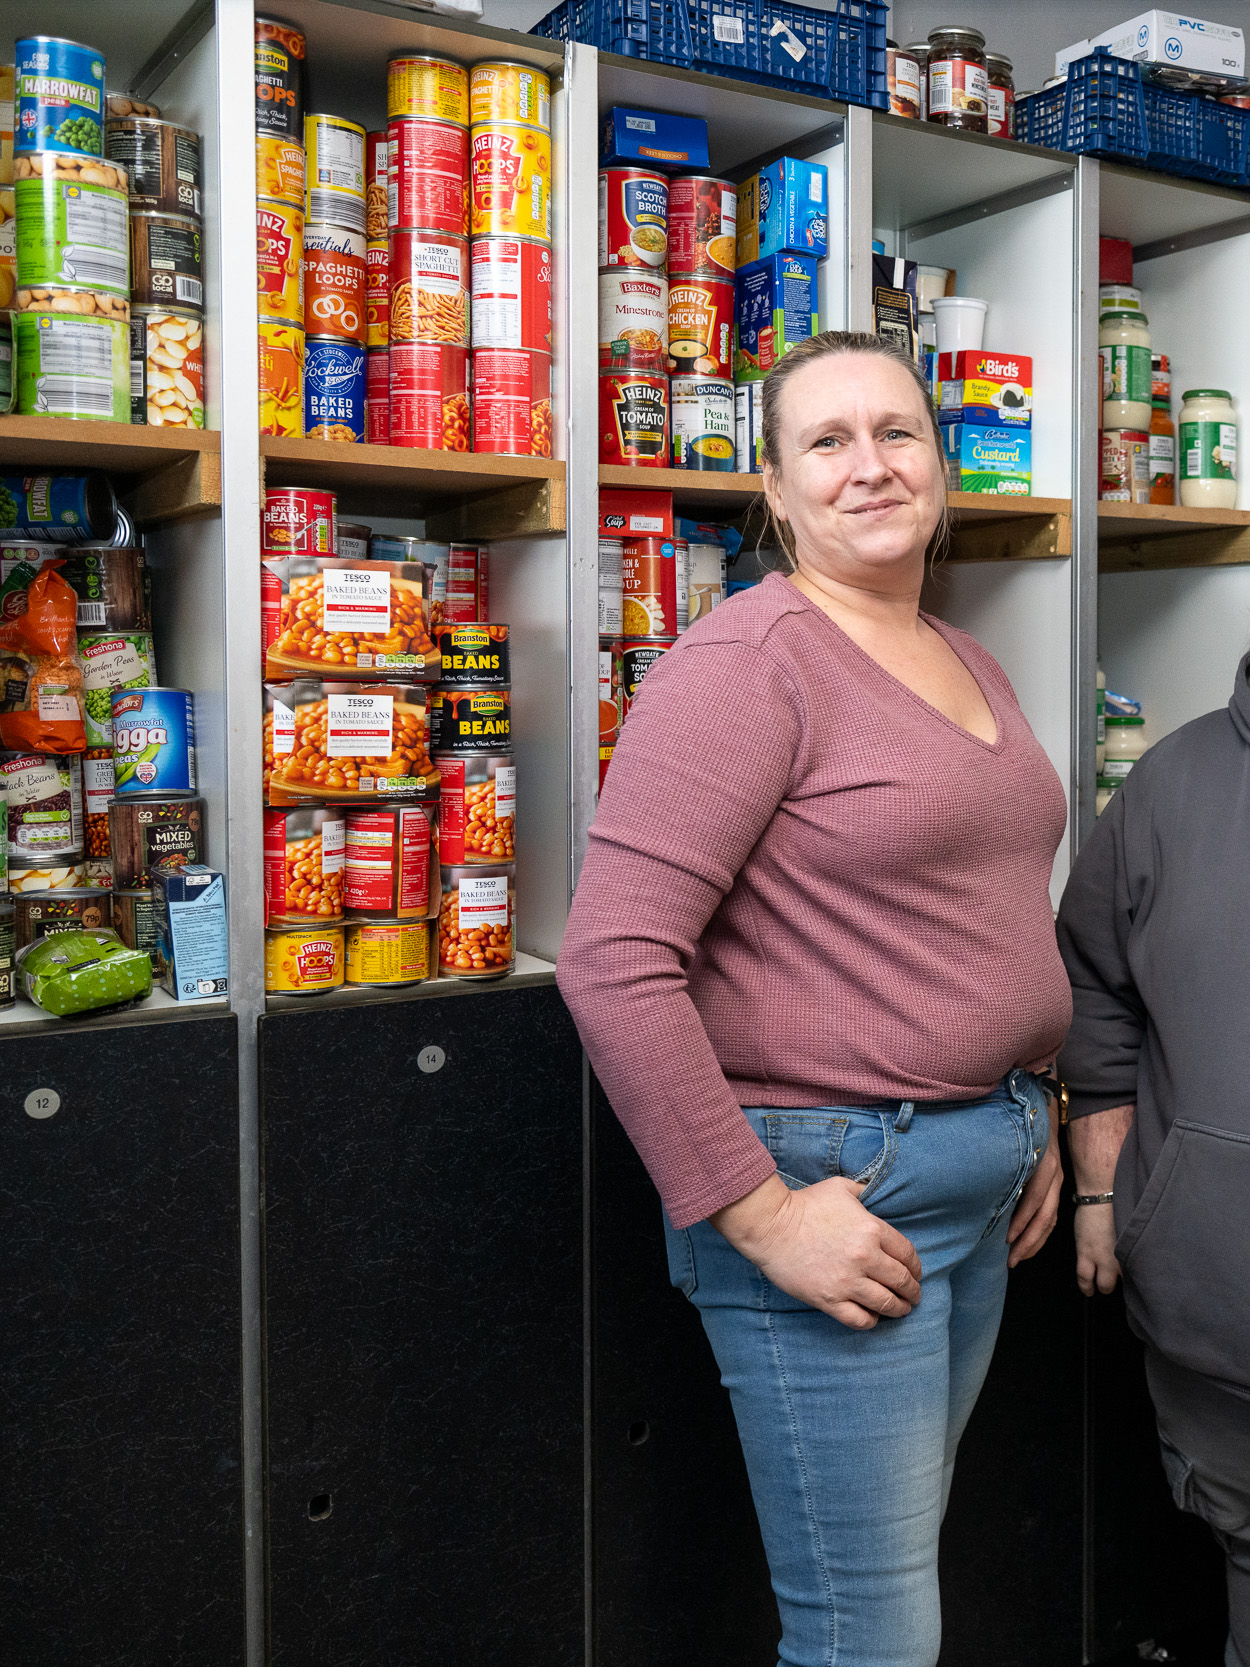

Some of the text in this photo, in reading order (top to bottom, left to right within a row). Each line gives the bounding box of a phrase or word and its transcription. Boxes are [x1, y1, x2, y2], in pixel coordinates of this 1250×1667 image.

[1178, 18, 1206, 32] PVC
[1221, 58, 1237, 67] 100
[24, 78, 97, 105] MARROWFAT
[474, 135, 512, 153] HEINZ
[178, 184, 193, 199] GO
[635, 190, 667, 206] SCOTCH
[178, 194, 194, 205] local
[788, 190, 796, 218] VEGETABLE
[638, 201, 667, 216] BROTH
[427, 246, 449, 254] TESCO
[414, 253, 459, 266] SHORT CUT
[303, 261, 365, 281] SPAGHETTI
[414, 262, 459, 274] SPAGHETTI
[152, 274, 173, 286] GO
[315, 273, 358, 290] LOOPS
[152, 283, 173, 293] local
[623, 282, 660, 297] Baxters
[671, 291, 705, 306] HEINZ
[615, 304, 665, 319] Minestrone
[668, 312, 708, 325] CHICKEN
[304, 357, 363, 377] tockwell
[986, 359, 1019, 378] Bird's
[697, 384, 734, 398] DUNCAN'S
[971, 383, 990, 392] Brandy
[972, 390, 989, 398] Sauce
[626, 387, 661, 402] HEINZ
[310, 395, 353, 408] BAKED
[311, 405, 353, 418] BEANS
[704, 408, 730, 421] Pea &
[620, 411, 664, 426] TOMATO
[704, 419, 729, 432] Ham
[972, 445, 1020, 463] Custard
[270, 505, 298, 513] BAKED
[263, 512, 307, 524] BEANS
[343, 573, 371, 581] TESCO
[326, 585, 388, 595] BAKED BEANS
[453, 634, 488, 643] Branston
[86, 641, 124, 657] Freshona
[84, 655, 135, 678] Garden Peas
[441, 655, 500, 669] BEANS
[108, 669, 124, 679] Water
[472, 700, 503, 709] Branston
[330, 711, 390, 719] BAKED BEANS
[119, 718, 163, 728] Marrowfat
[459, 719, 509, 735] BEANS
[113, 727, 167, 753] igga
[3, 757, 43, 774] Freshona
[115, 753, 139, 767] peas
[27, 771, 56, 787] Beans
[26, 787, 41, 796] Water
[138, 811, 152, 820] GO
[155, 830, 192, 843] MIXED
[151, 840, 194, 852] vegetables
[474, 881, 497, 889] TESCO
[460, 889, 507, 899] BAKED BEANS
[29, 906, 42, 914] GO
[85, 914, 100, 924] 79p
[304, 943, 333, 955] HEINZ
[300, 956, 334, 967] HOOPS
[425, 1054, 437, 1064] 14
[36, 1097, 50, 1109] 12
